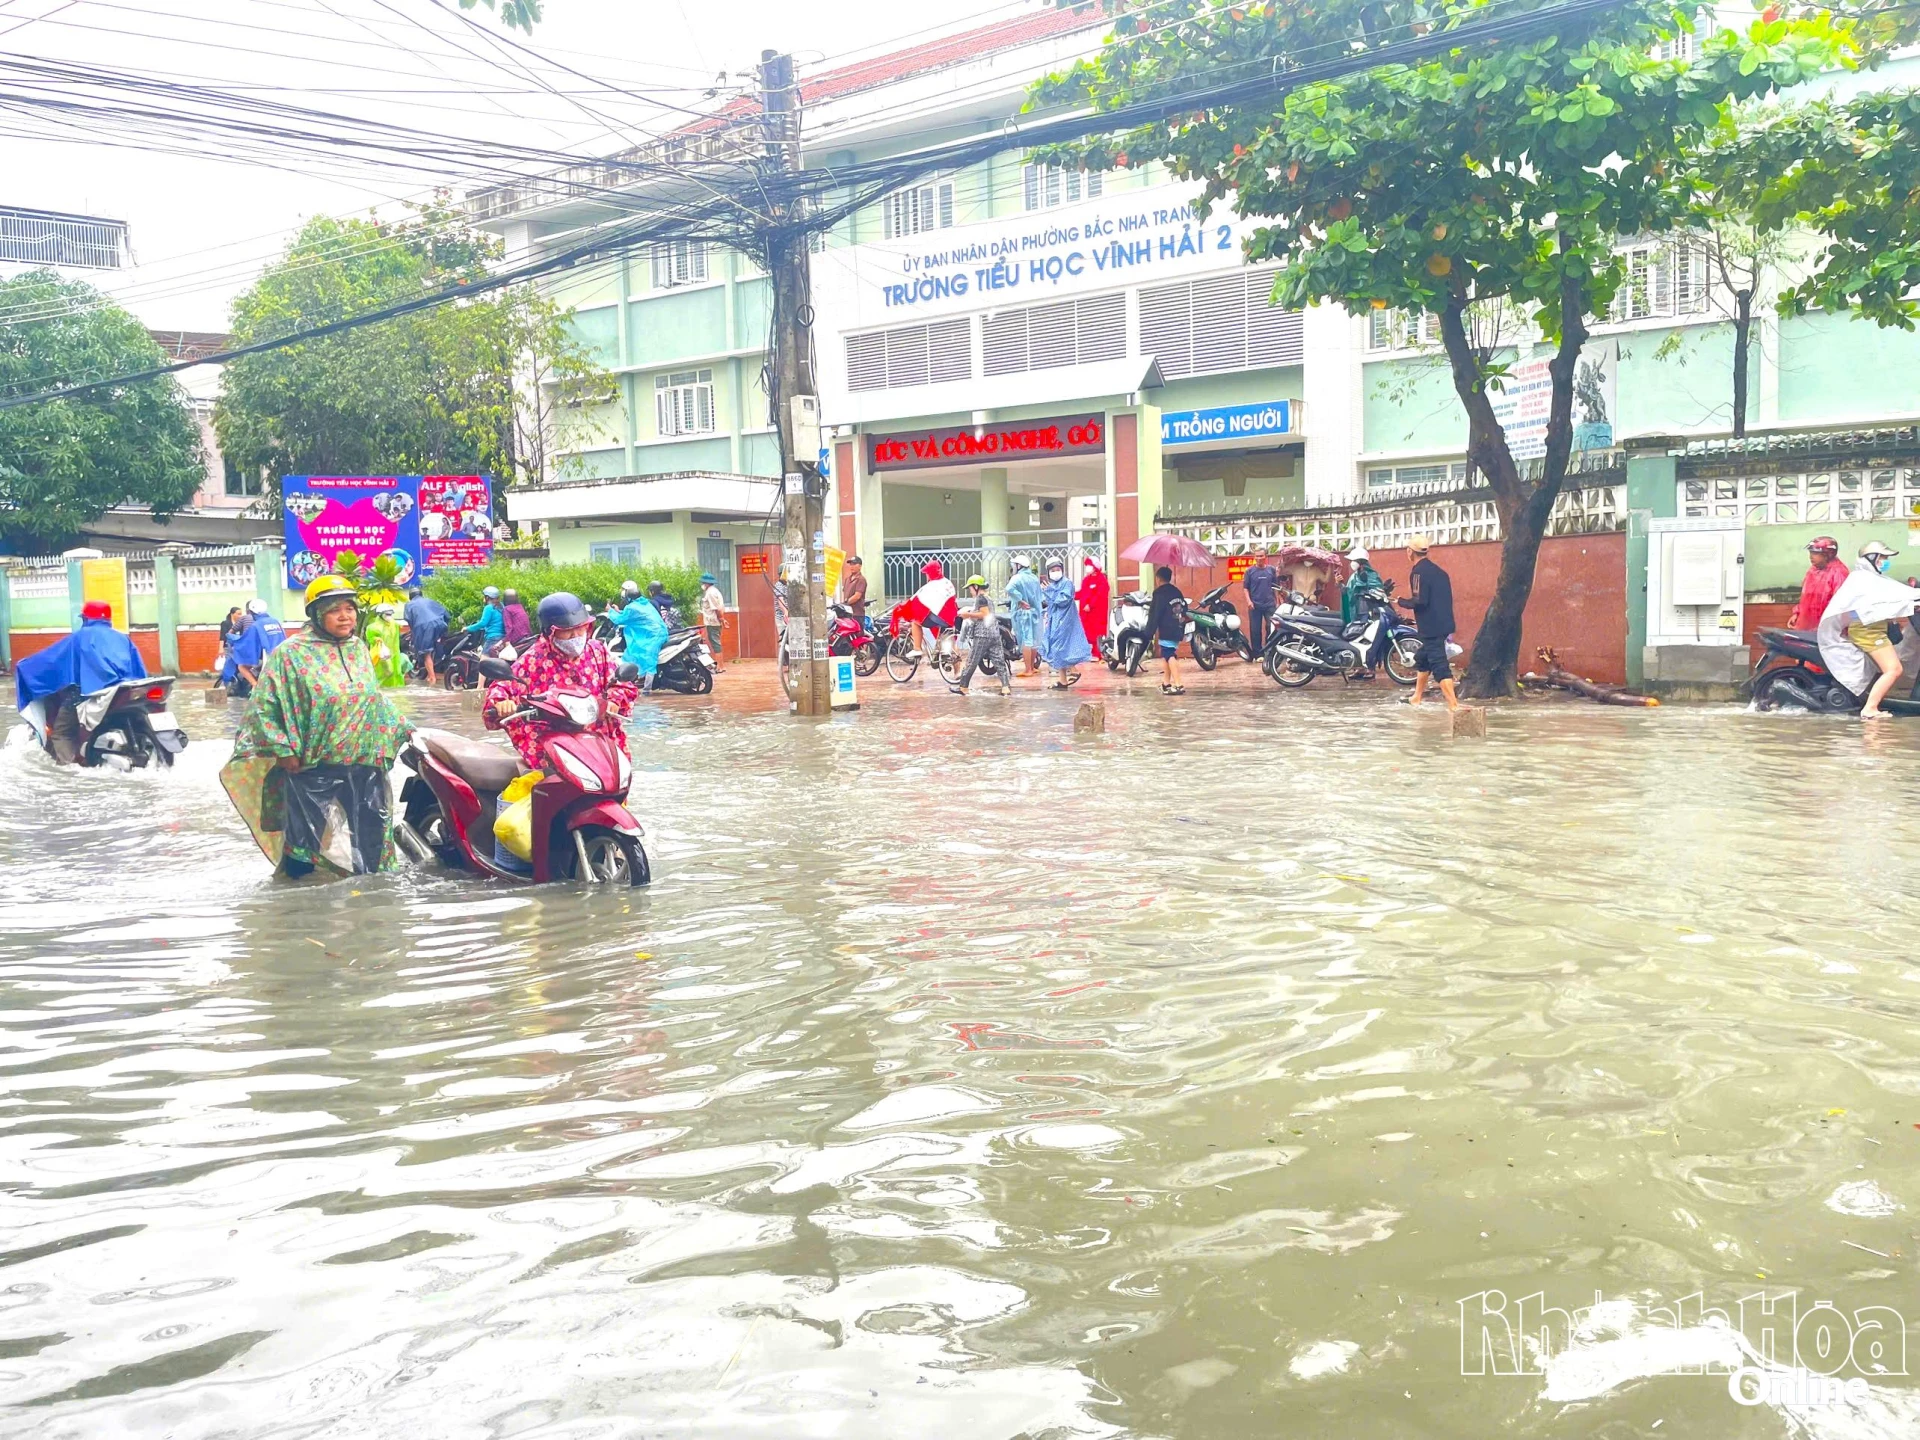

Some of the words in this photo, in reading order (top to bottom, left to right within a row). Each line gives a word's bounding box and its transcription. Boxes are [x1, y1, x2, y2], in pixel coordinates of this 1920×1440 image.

[903, 253, 920, 272] ỦY
[925, 252, 948, 269] BAN
[952, 243, 987, 264] NHÂN
[991, 237, 1018, 256] DÂN
[1022, 225, 1079, 250] PHƯỜNG
[1084, 214, 1114, 238] BẮC
[1119, 214, 1149, 232] NHA
[883, 272, 969, 307] TRƯỜNG
[975, 256, 1020, 292] TIỂU
[1030, 252, 1085, 285] HỌC
[1092, 239, 1151, 270] VĨNH
[1160, 223, 1203, 260] HẢI
[1217, 224, 1232, 250] 2
[1173, 412, 1225, 437] TRỒNG
[1230, 407, 1281, 432] NGƯỜI
[911, 434, 940, 459] VÀ
[942, 432, 999, 457] CÔNG
[421, 482, 442, 490] ALF
[316, 524, 361, 534] TRƯỜNG
[364, 526, 385, 535] HỌC
[321, 538, 350, 547] HẠNH
[354, 536, 382, 545] PHÚC
